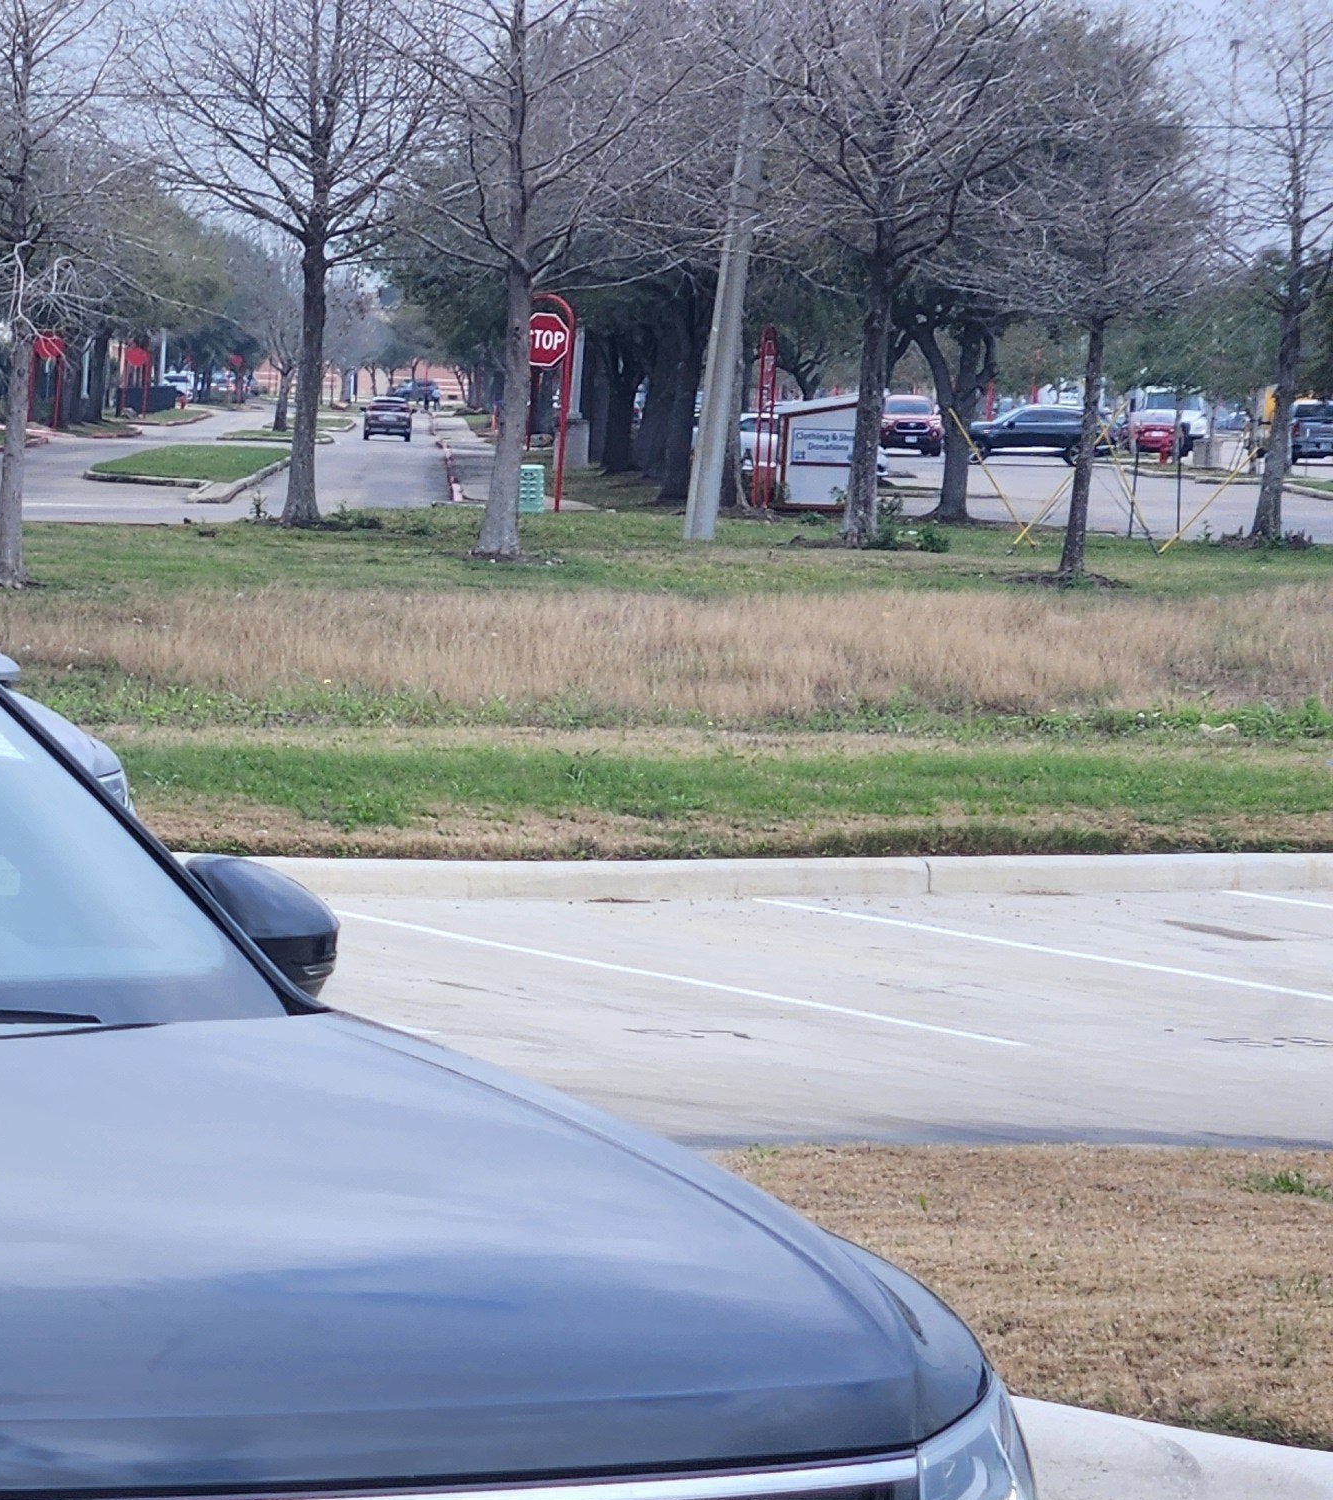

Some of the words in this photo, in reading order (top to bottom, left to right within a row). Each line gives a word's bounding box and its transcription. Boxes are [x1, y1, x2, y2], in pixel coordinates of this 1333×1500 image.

[530, 329, 565, 350] TOP
[796, 432, 830, 442] Clothing
[808, 442, 849, 451] Donations
